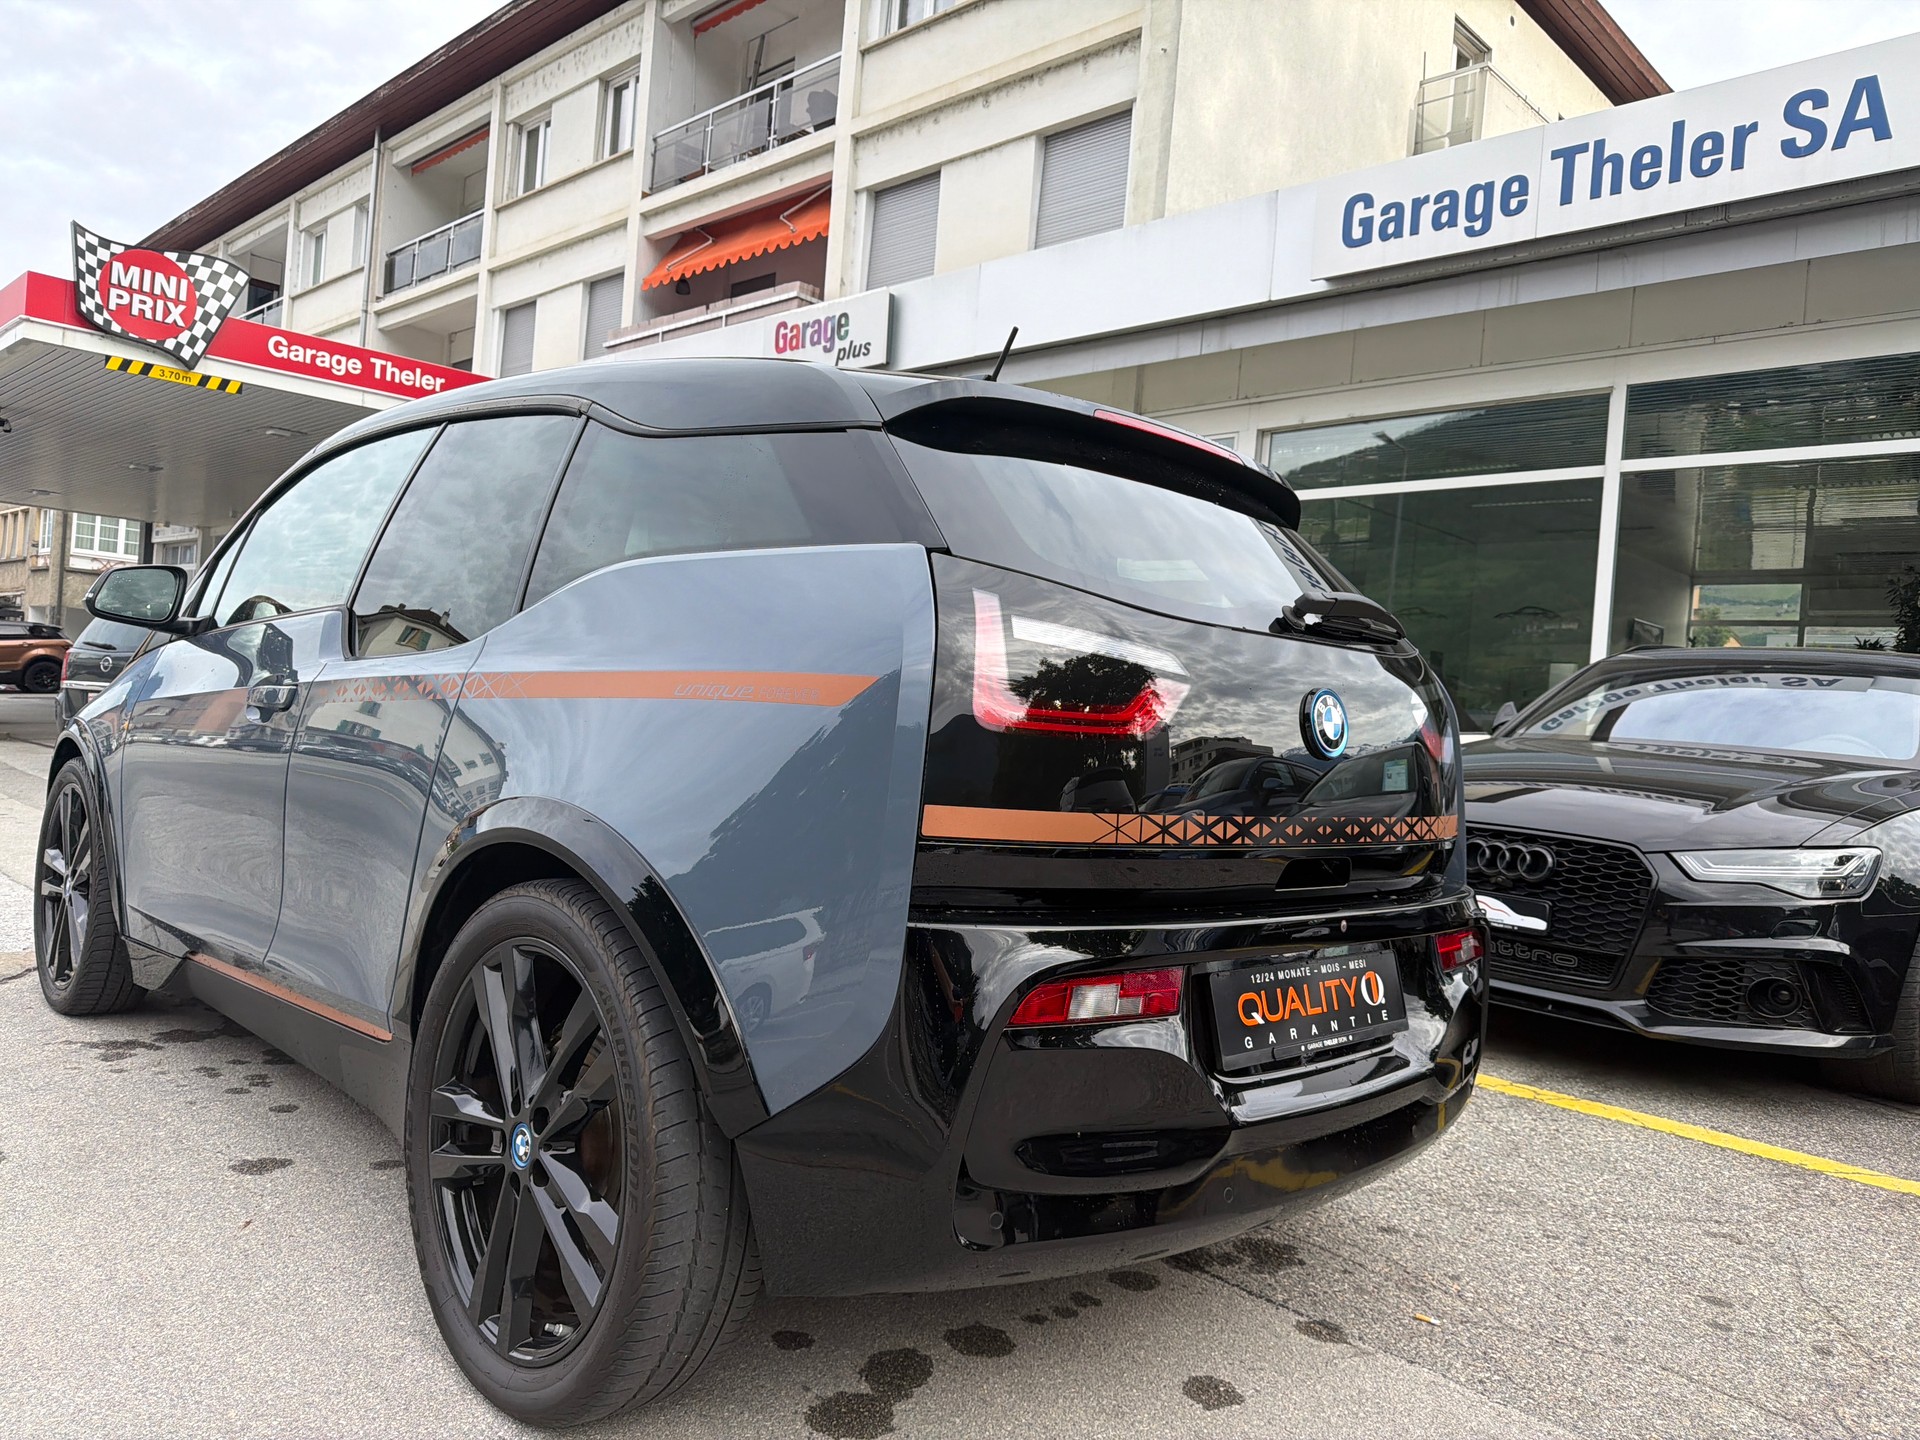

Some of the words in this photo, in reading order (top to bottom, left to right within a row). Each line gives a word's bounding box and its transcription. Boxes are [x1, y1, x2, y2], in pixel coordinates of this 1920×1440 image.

[1341, 172, 1529, 249] Garage
[1550, 119, 1759, 206] Theler
[1780, 74, 1892, 159] SA
[110, 261, 188, 302] MINI
[108, 287, 187, 327] PRIX
[774, 312, 849, 354] Garage
[835, 340, 871, 366] plus
[267, 335, 362, 375] Garage
[370, 357, 445, 391] Theler
[674, 683, 754, 699] unique
[1250, 972, 1275, 984] 12/24
[1278, 967, 1311, 980] MONATE
[1321, 963, 1340, 974] MOIS
[1349, 959, 1367, 969] MESI
[1244, 1009, 1389, 1049] GARANTIE
[600, 982, 639, 1214] BRIDGESTONE
